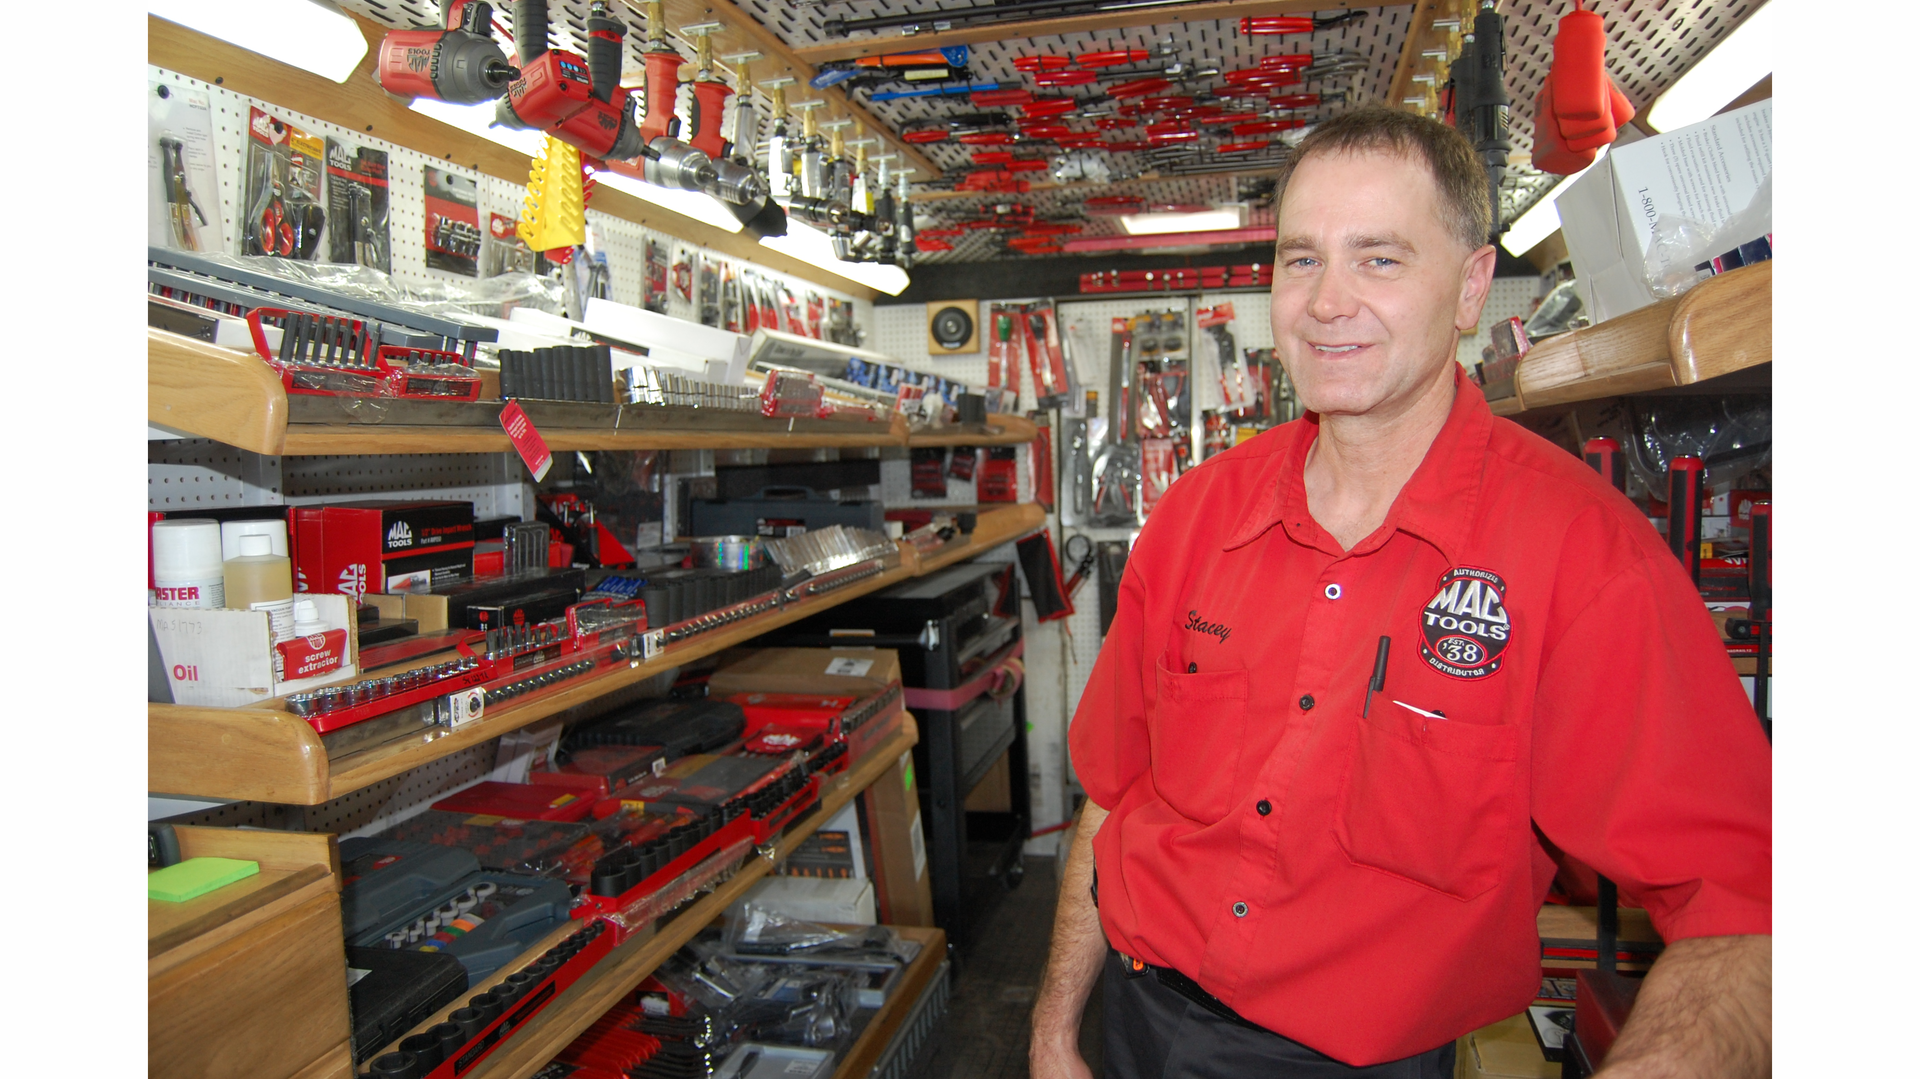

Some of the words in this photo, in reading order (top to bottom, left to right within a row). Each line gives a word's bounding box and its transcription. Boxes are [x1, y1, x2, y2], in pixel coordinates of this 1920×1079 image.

[330, 145, 351, 164] MAC
[1710, 124, 1722, 150] Standard
[1718, 151, 1731, 182] Accessories
[330, 160, 352, 171] TOOLS
[388, 520, 412, 541] MAC
[388, 538, 412, 548] TOOLS
[156, 586, 200, 600] ASTER
[1427, 580, 1508, 624] MAC
[1184, 610, 1232, 644] Stacey
[1424, 611, 1507, 640] TOOLS
[298, 656, 338, 674] extractor
[305, 650, 332, 663] screw
[173, 664, 198, 681] Oil
[1428, 657, 1484, 676] DISTRIBUTOR
